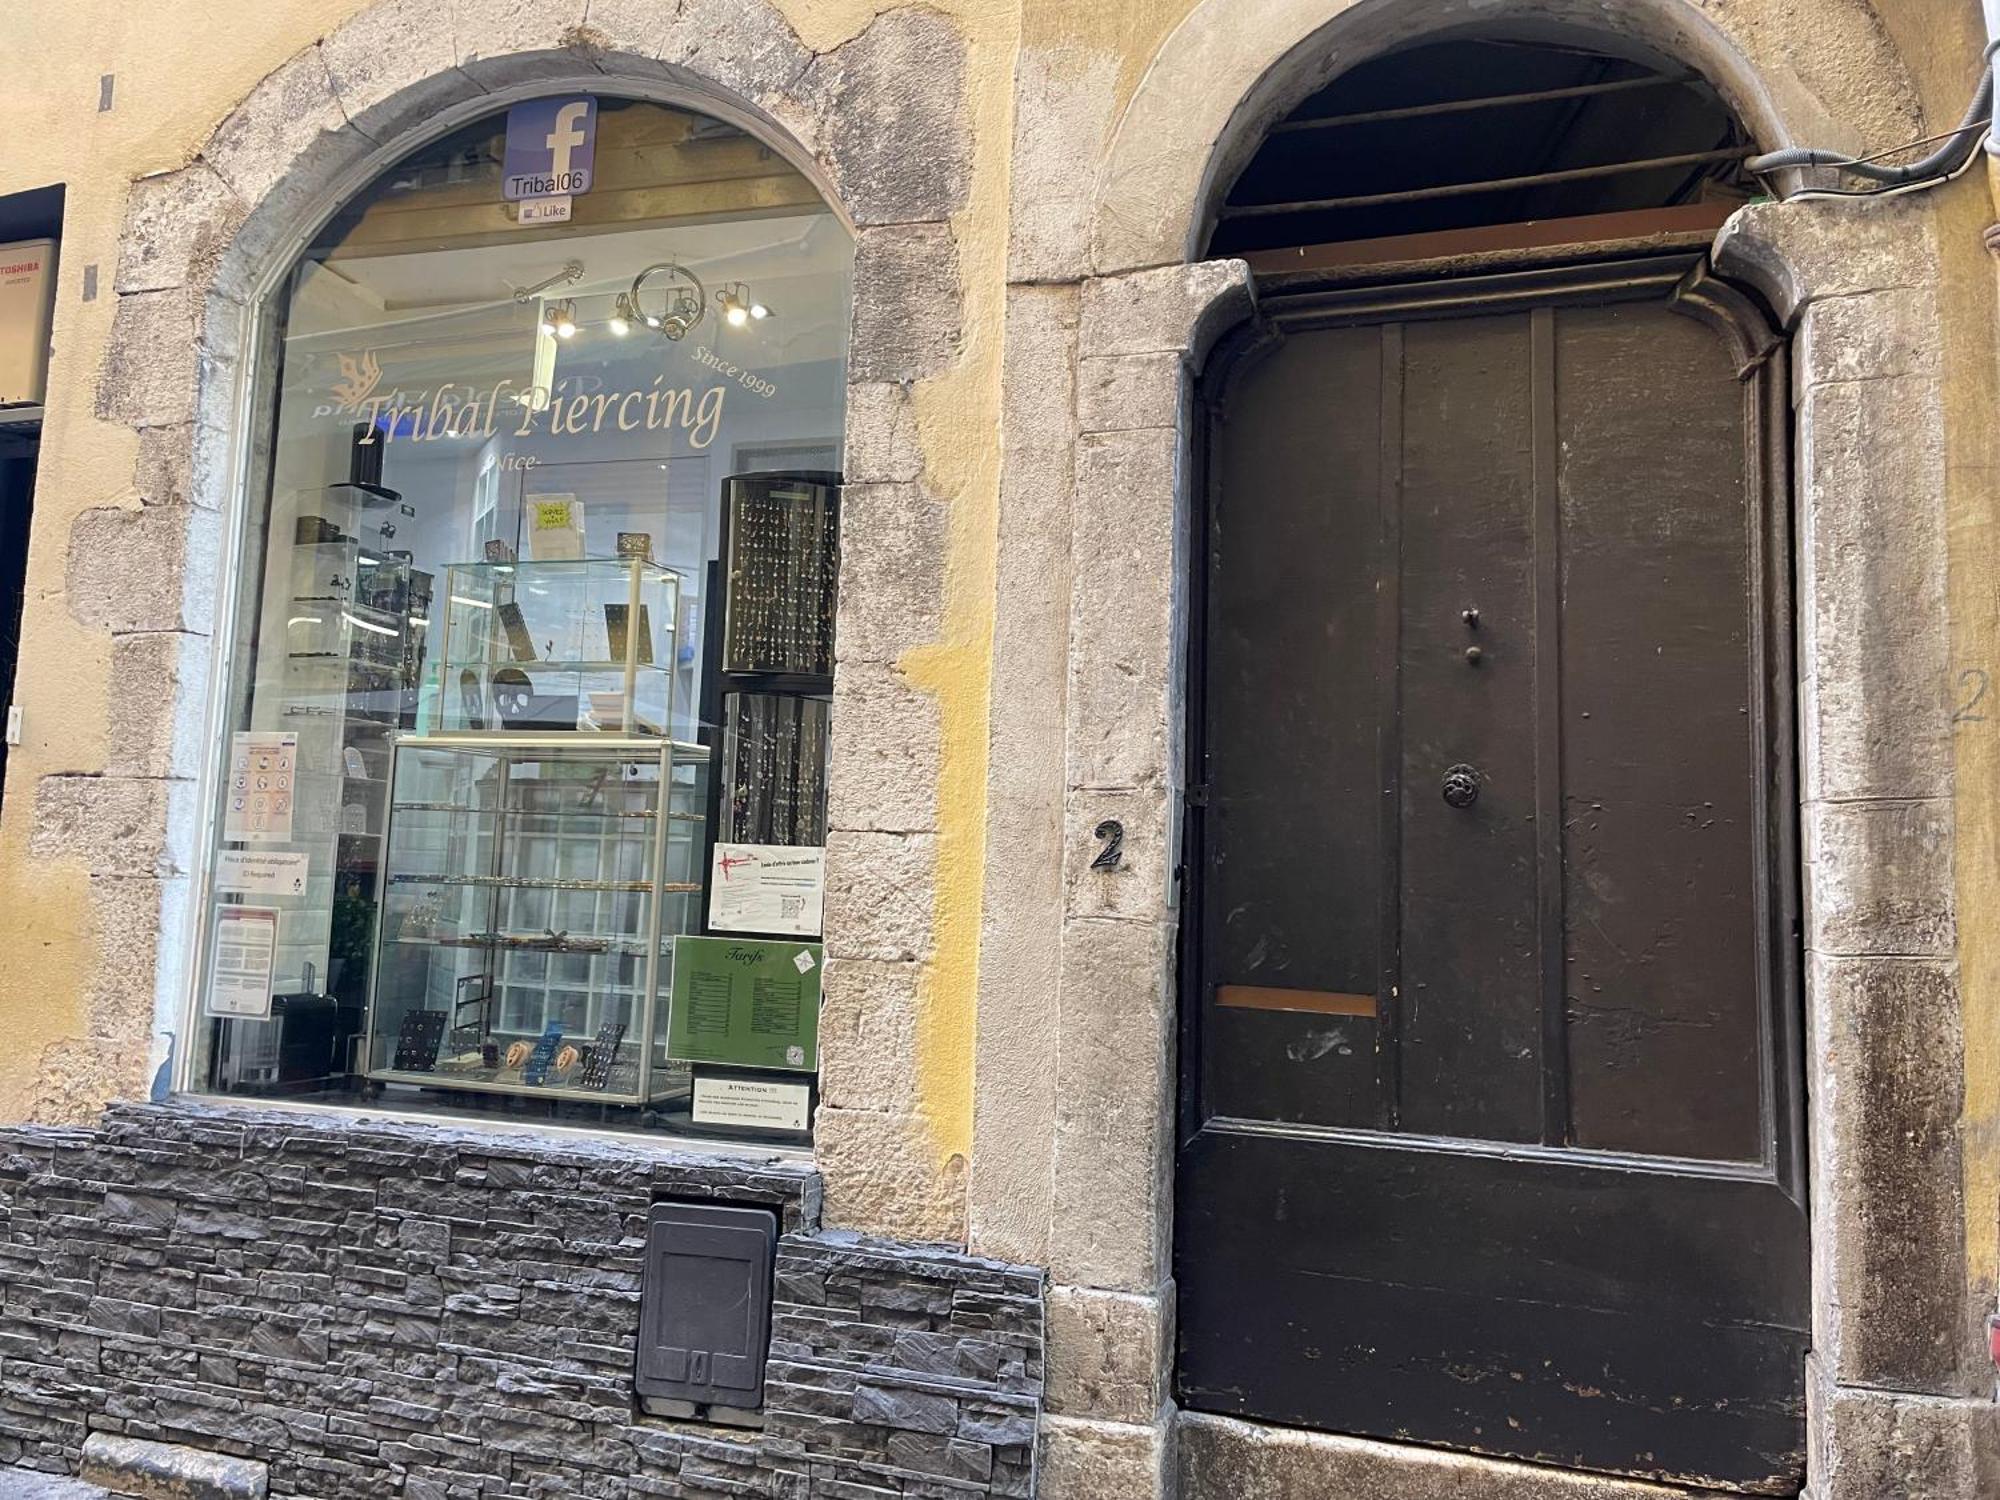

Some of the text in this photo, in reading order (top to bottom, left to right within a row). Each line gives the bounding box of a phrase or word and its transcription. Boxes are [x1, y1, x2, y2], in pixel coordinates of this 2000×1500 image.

[512, 171, 583, 195] Tribal06
[543, 204, 567, 217] Like
[0, 262, 40, 274] TOSHIBA
[690, 345, 777, 399] Since 1999
[357, 374, 726, 449] Tribal Piercing
[1952, 669, 1989, 724] 2
[1091, 820, 1123, 869] 2
[725, 947, 764, 966] Tarifs
